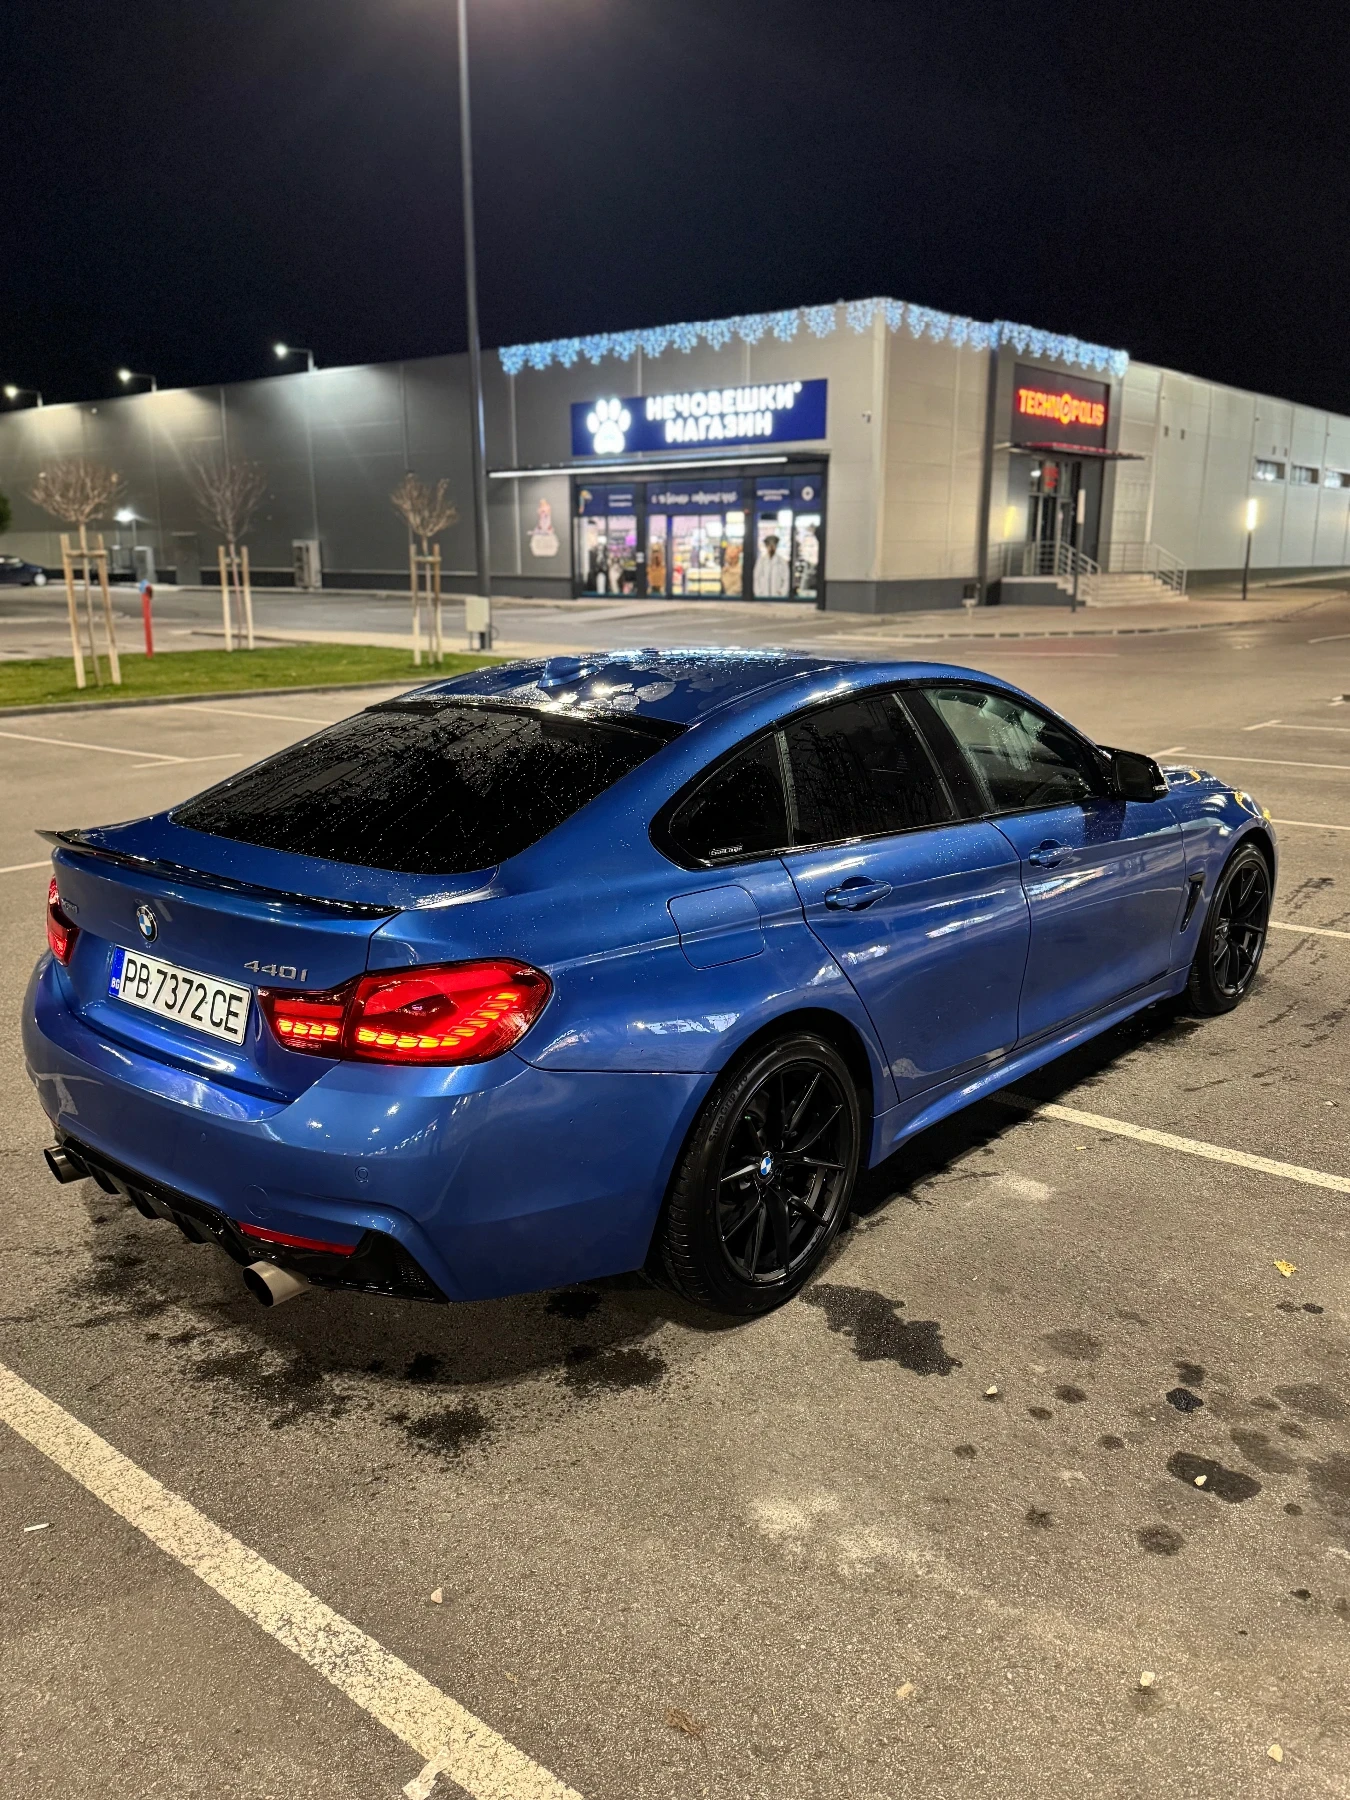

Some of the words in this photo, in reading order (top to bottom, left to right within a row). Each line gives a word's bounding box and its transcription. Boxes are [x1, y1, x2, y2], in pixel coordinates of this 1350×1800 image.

[646, 383, 795, 421] НЕЧОВЕШКИ
[1018, 388, 1105, 426] TECHNOPOLIS
[665, 410, 773, 443] МАГАЗИН
[111, 976, 121, 990] BG
[734, 1075, 748, 1092] Pro
